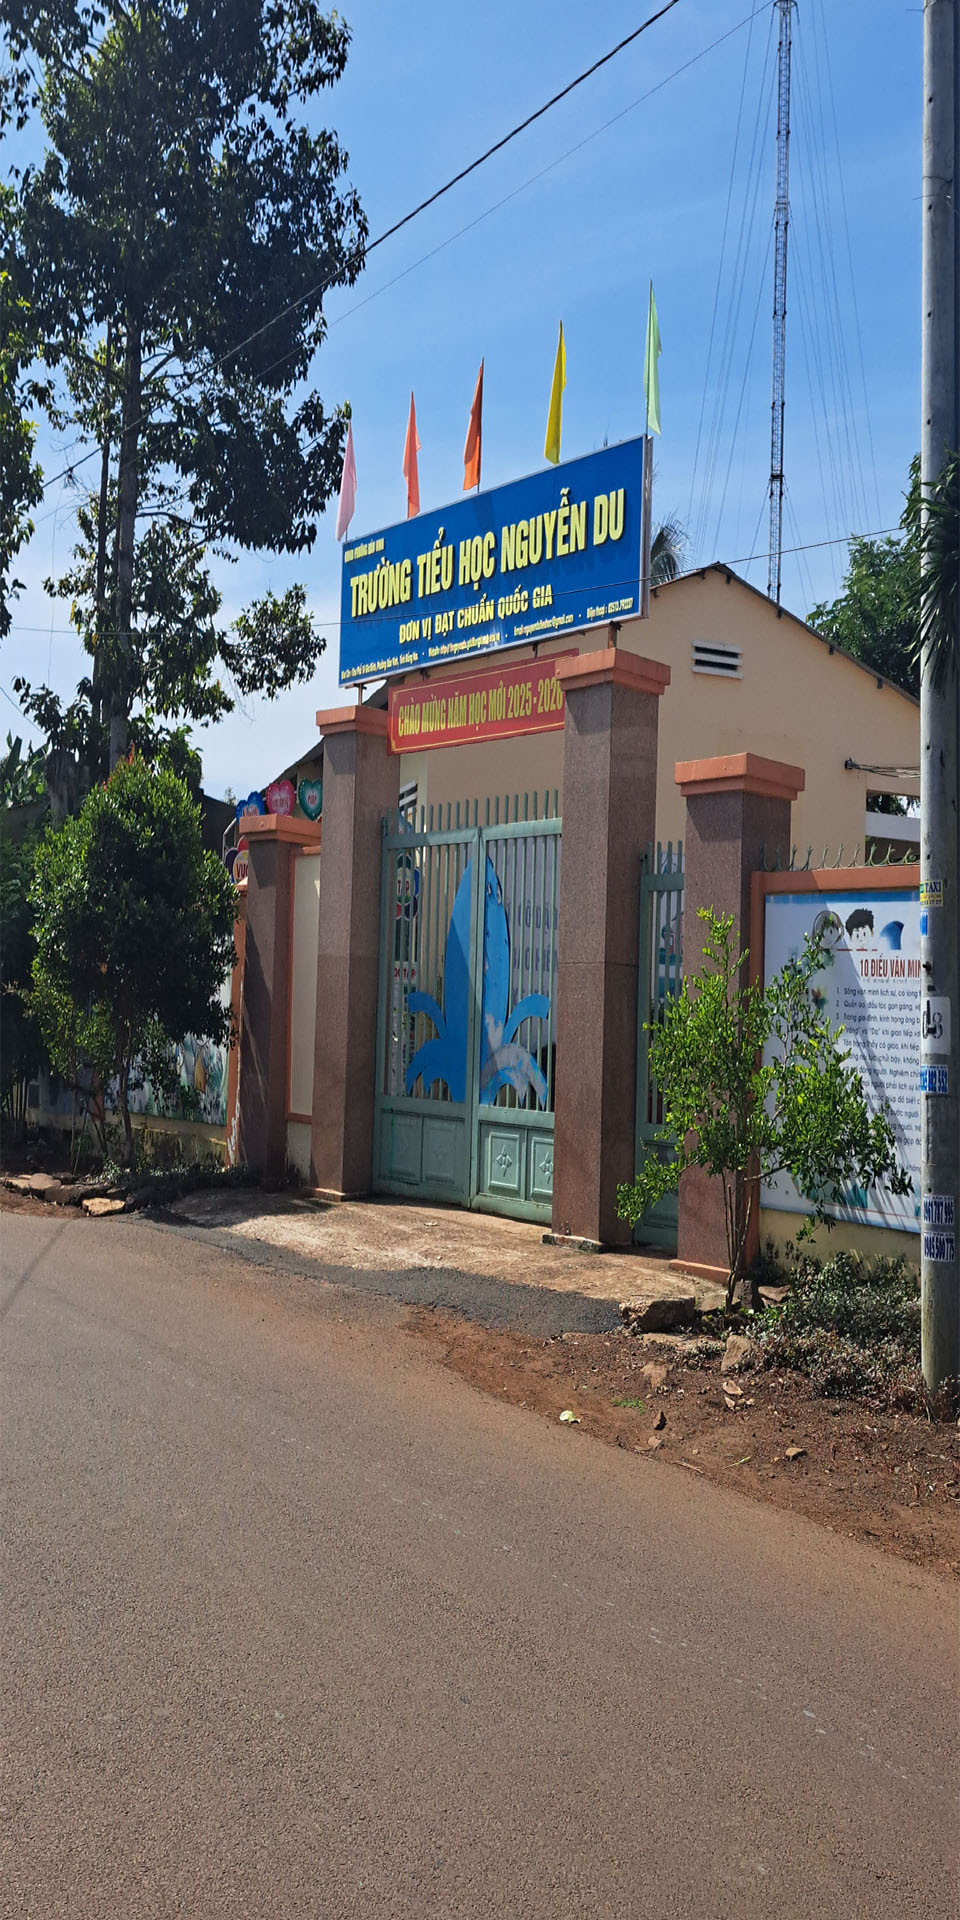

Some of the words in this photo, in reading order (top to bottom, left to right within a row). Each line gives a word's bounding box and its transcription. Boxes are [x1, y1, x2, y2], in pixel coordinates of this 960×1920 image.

[350, 556, 412, 618] TRƯỜNG
[416, 527, 454, 599] TIỂU
[458, 532, 495, 591] HỌC
[500, 487, 587, 573] NGUYỄN
[593, 488, 625, 546] DU
[399, 615, 420, 644] ĐƠN
[422, 616, 432, 640] VỊ
[434, 611, 455, 637] ĐẠT
[457, 593, 494, 629] CHUẨN
[497, 584, 529, 619] QUỐC
[532, 584, 553, 609] GIA
[398, 697, 420, 737] CHÀO
[421, 693, 446, 733] MỪNG
[447, 691, 467, 729] NĂM
[468, 690, 487, 731] HỌC
[488, 680, 506, 722] MỚI
[925, 881, 942, 893] TAXI
[860, 958, 869, 977] 10
[890, 955, 906, 978] VĂN
